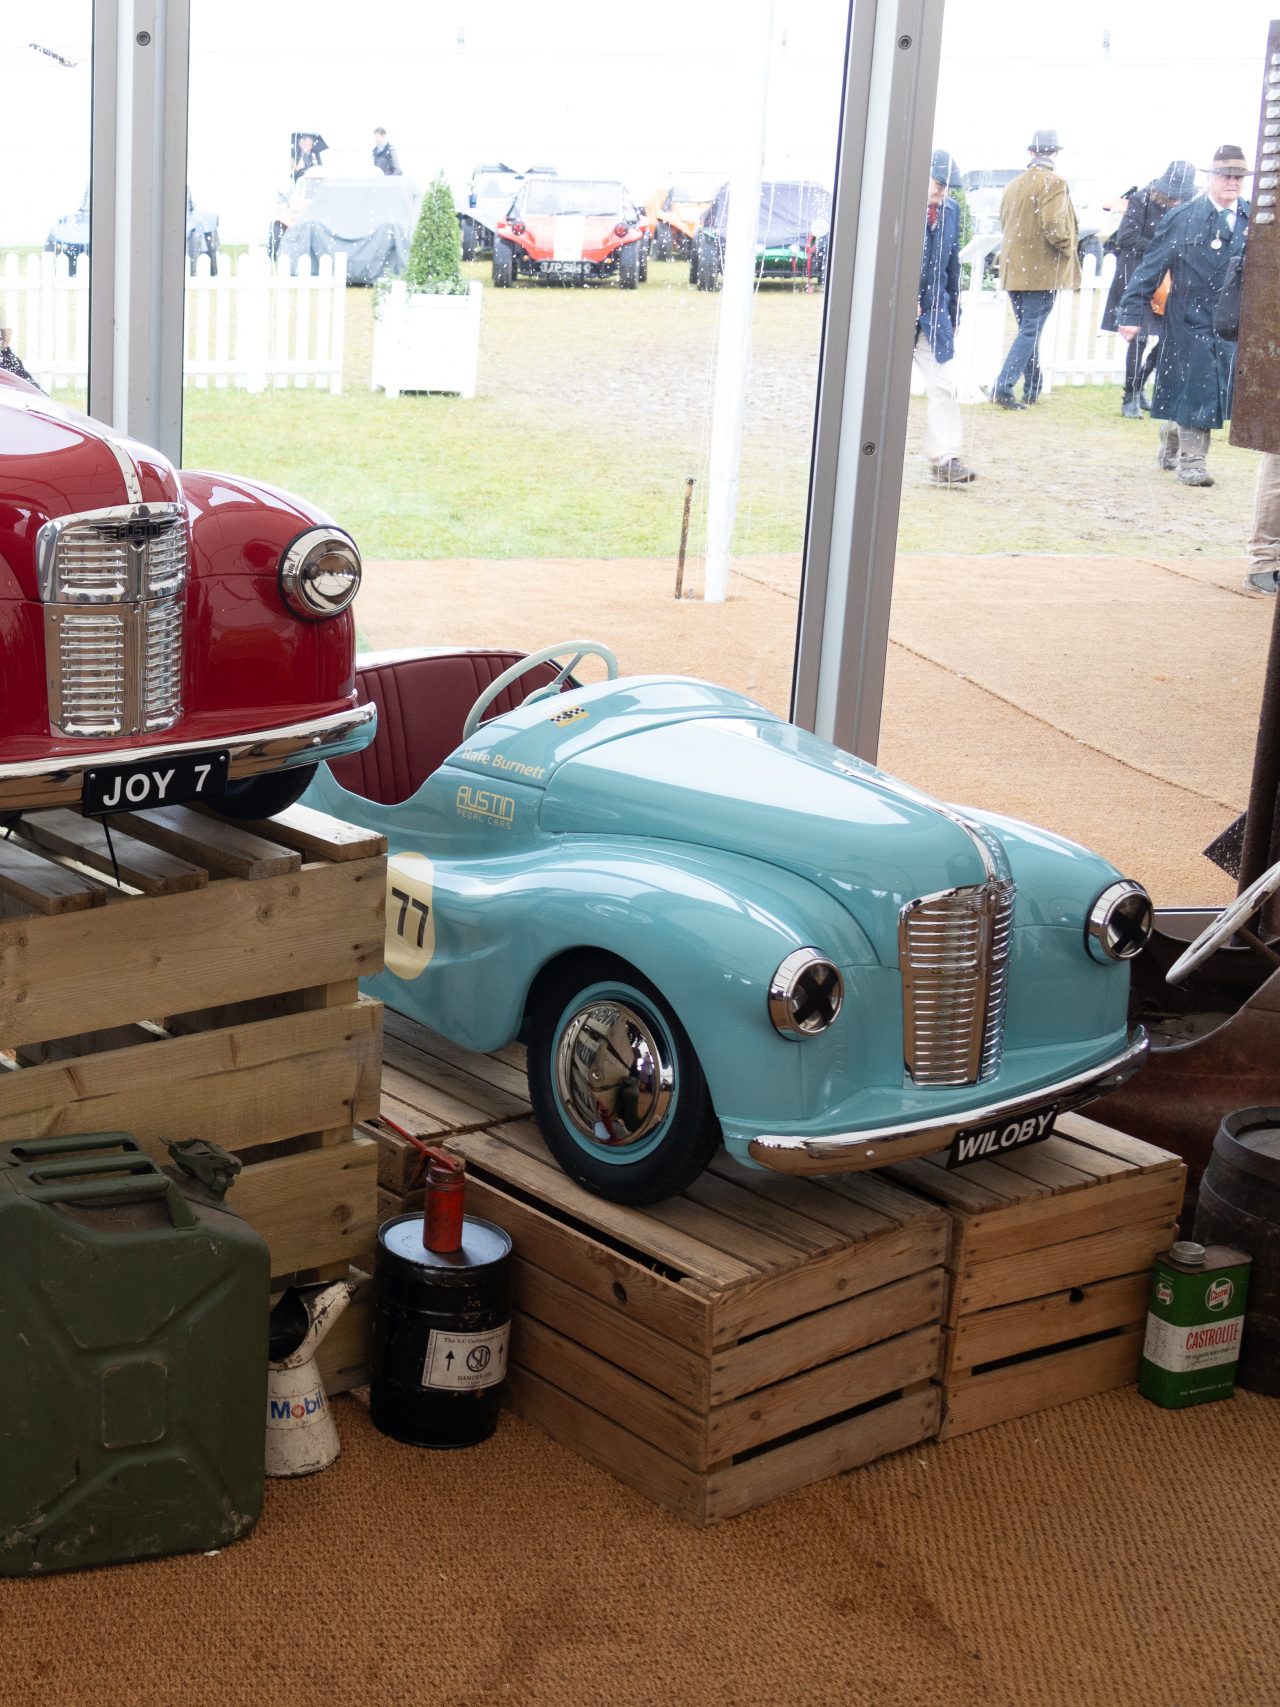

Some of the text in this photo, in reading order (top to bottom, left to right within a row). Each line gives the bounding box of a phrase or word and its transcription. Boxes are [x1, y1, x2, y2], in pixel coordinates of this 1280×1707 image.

[461, 747, 545, 780] Rafe Burnett
[102, 764, 211, 807] JOY 7
[456, 785, 515, 822] AUSTIN
[456, 808, 512, 830] PEDAL CARS
[391, 886, 429, 949] 77
[958, 1110, 1055, 1161] WILOBY
[1185, 1323, 1239, 1351] CASTROLITE
[270, 1389, 325, 1419] Mobil
